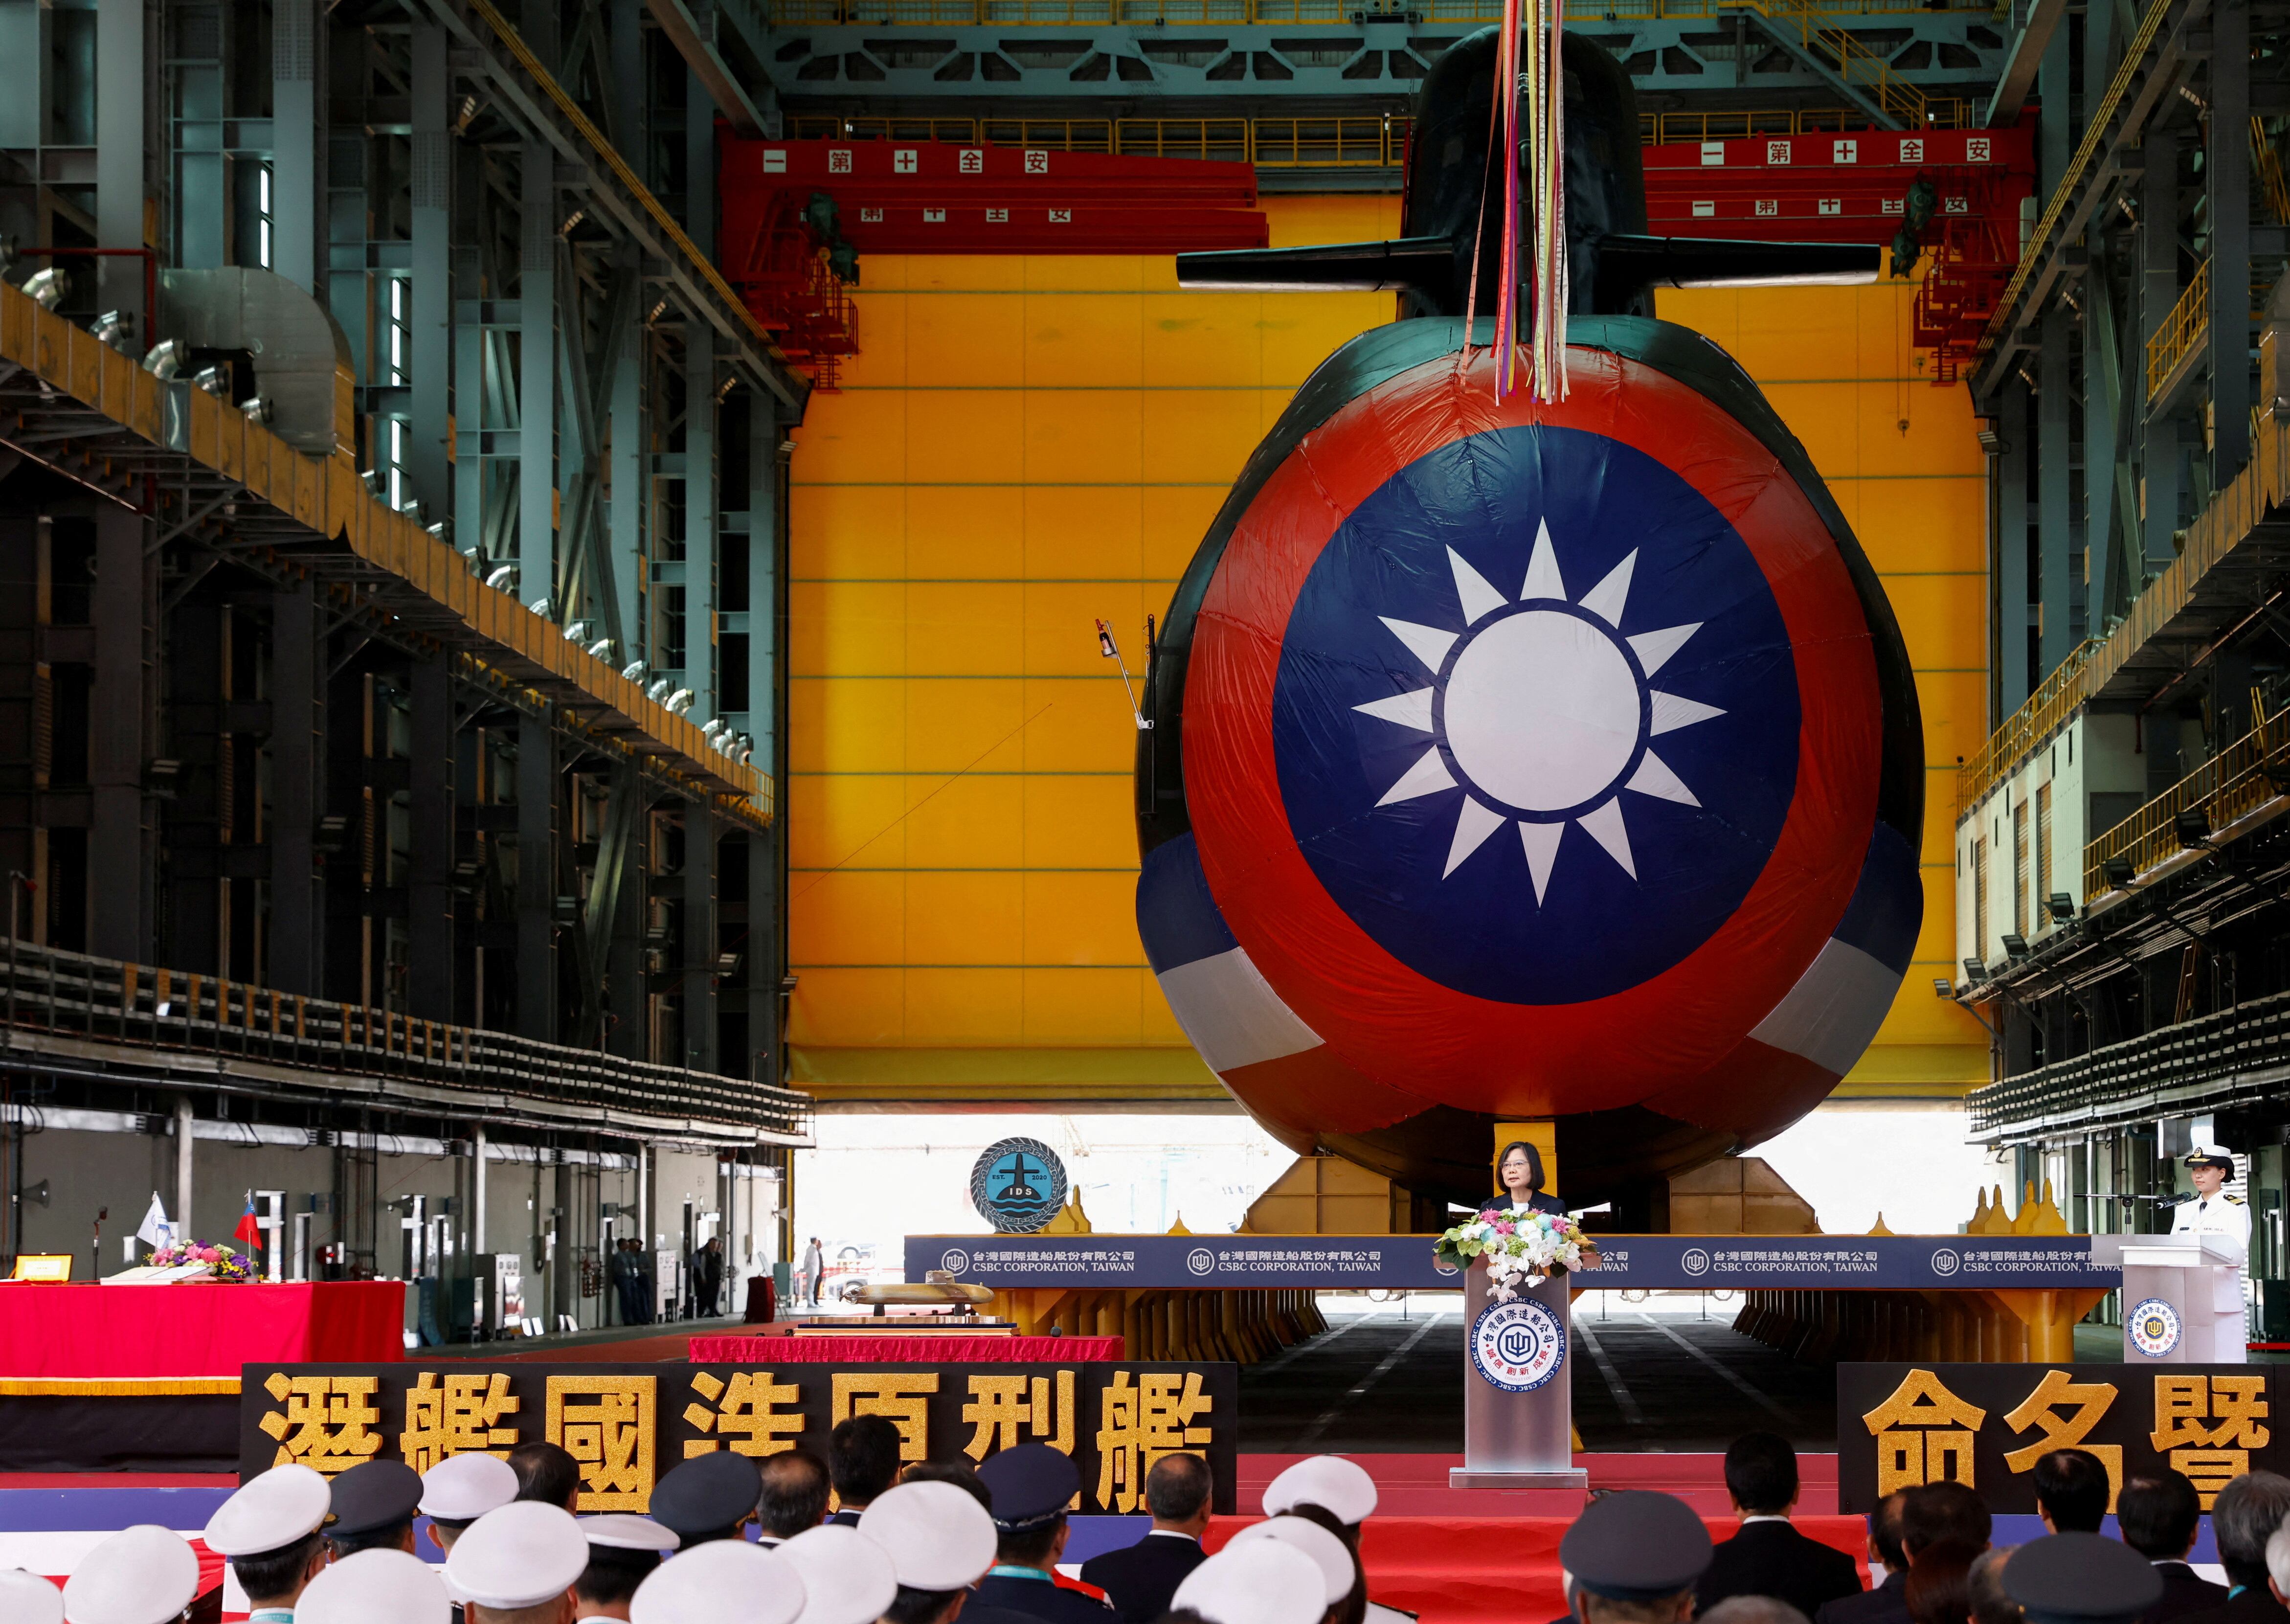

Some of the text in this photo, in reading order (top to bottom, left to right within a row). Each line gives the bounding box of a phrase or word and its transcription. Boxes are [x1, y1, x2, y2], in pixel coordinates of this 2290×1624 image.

[972, 1251, 1134, 1262] 台灣國際造船股份有限公司
[1218, 1251, 1381, 1261] 台灣國際造船股份有限公司
[1713, 1251, 1877, 1261] 台灣國際造船股份有限公司
[972, 1263, 1135, 1273] CSBC CORPORATION, TAIWAN
[1218, 1262, 1381, 1273] CSBC CORPORATION, TAIWAN
[1713, 1263, 1878, 1273] CSBC CORPORATION, TAIWAN
[1963, 1263, 2123, 1273] CSBC CORPORATION, TAIWA
[1529, 1300, 1548, 1311] CSBC
[1476, 1310, 1489, 1327] CSBC
[1548, 1311, 1561, 1329] CSBC
[1482, 1308, 1554, 1343] 台灣國際造船公司
[1472, 1350, 1482, 1369] CSBC
[1553, 1352, 1564, 1370] CSBC
[1481, 1369, 1497, 1384] CSBC
[1538, 1370, 1554, 1385] CSBC
[1498, 1382, 1517, 1391] CSBC
[1519, 1383, 1537, 1391] CSBC
